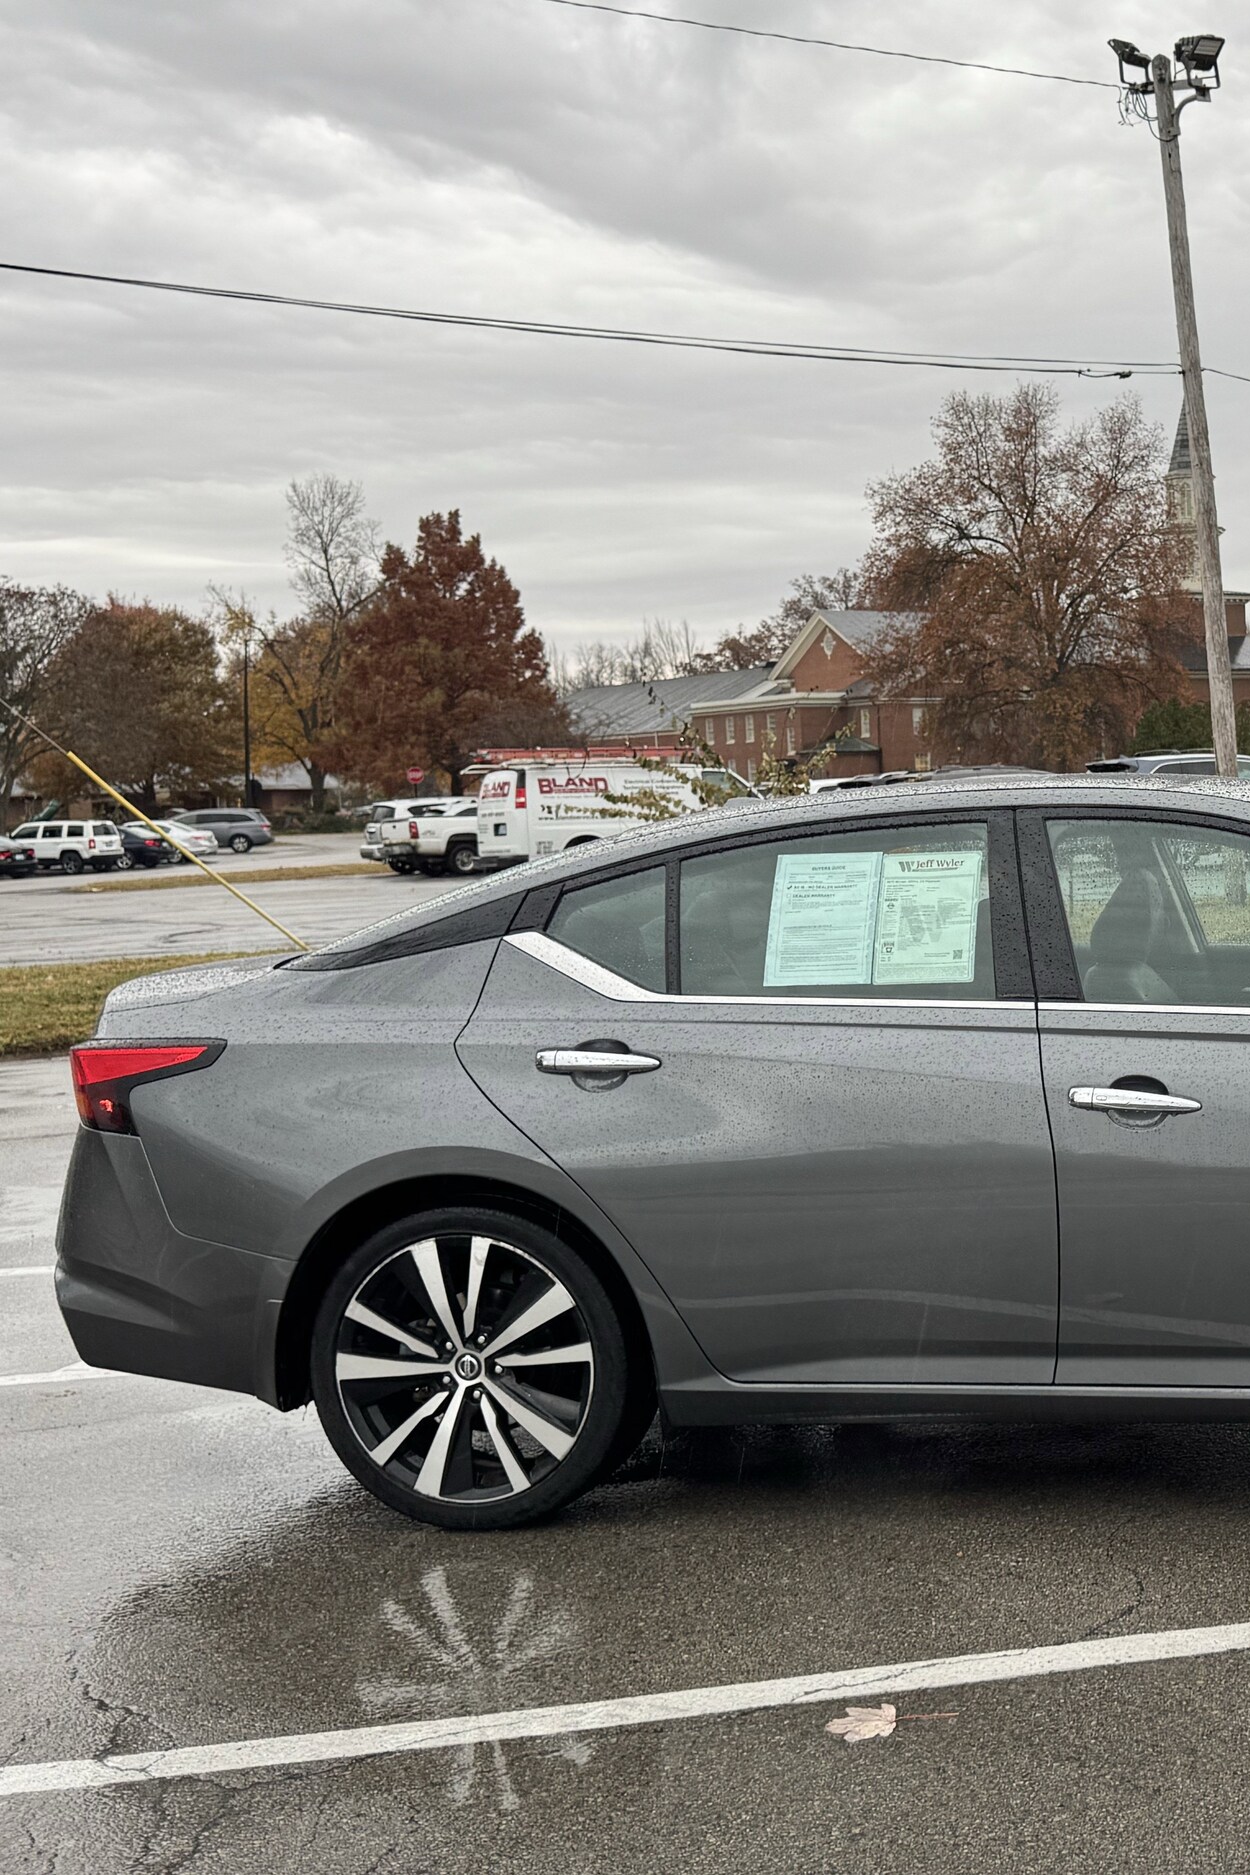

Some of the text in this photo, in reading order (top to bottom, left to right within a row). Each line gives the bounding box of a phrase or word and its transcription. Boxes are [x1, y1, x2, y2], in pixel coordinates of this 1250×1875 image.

[538, 778, 608, 794] BLAND
[916, 858, 965, 869] Jeff Wyler
